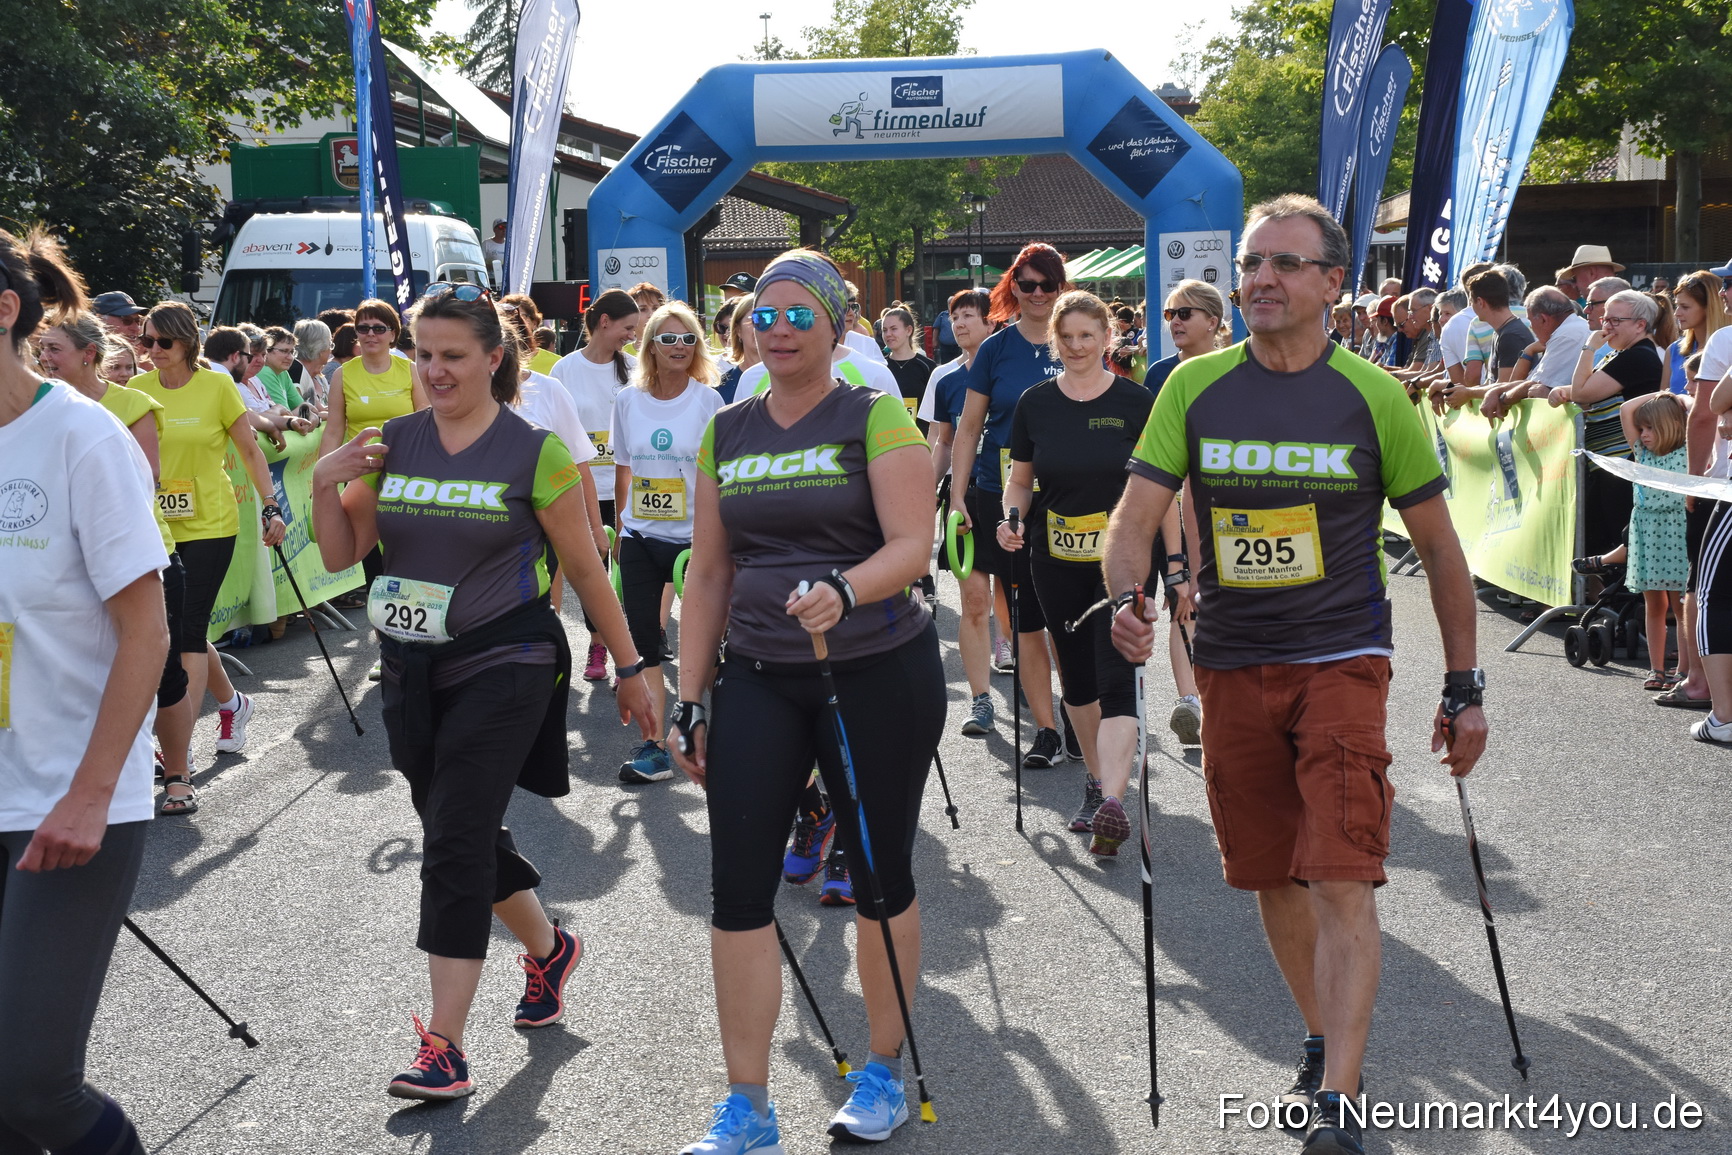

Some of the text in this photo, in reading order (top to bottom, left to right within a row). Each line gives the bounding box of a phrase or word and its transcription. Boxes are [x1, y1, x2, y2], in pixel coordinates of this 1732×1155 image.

[533, 1, 560, 112] Fischer
[545, 15, 566, 105] AUTOMOBILE
[903, 87, 940, 96] Fischer
[1374, 71, 1395, 143] Fischer
[1382, 82, 1397, 140] AUTOMOBILE
[874, 105, 988, 130] firmenlauf
[874, 130, 920, 139] neumarkt
[1127, 138, 1143, 147] das
[656, 155, 717, 168] Fischer
[1130, 145, 1175, 160] fährt mit!
[242, 242, 293, 254] abavent
[658, 454, 684, 462] Pöllinger
[717, 447, 840, 484] BOCK
[1201, 441, 1353, 475] BOCK
[379, 475, 504, 507] BOCK
[741, 484, 754, 495] by
[757, 481, 790, 492] smart
[794, 476, 848, 488] concepts
[1243, 477, 1257, 488] by
[1261, 479, 1299, 488] smart
[1303, 481, 1358, 493] concepts
[158, 493, 188, 510] 205
[642, 493, 673, 509] 462
[377, 503, 509, 523] nspired by smart concepts
[1226, 525, 1264, 534] firmenlauf
[1291, 526, 1311, 535] 2019
[1053, 530, 1100, 549] 2077
[1234, 537, 1296, 566] 295
[1268, 564, 1303, 574] Manfred
[384, 603, 428, 633] 292
